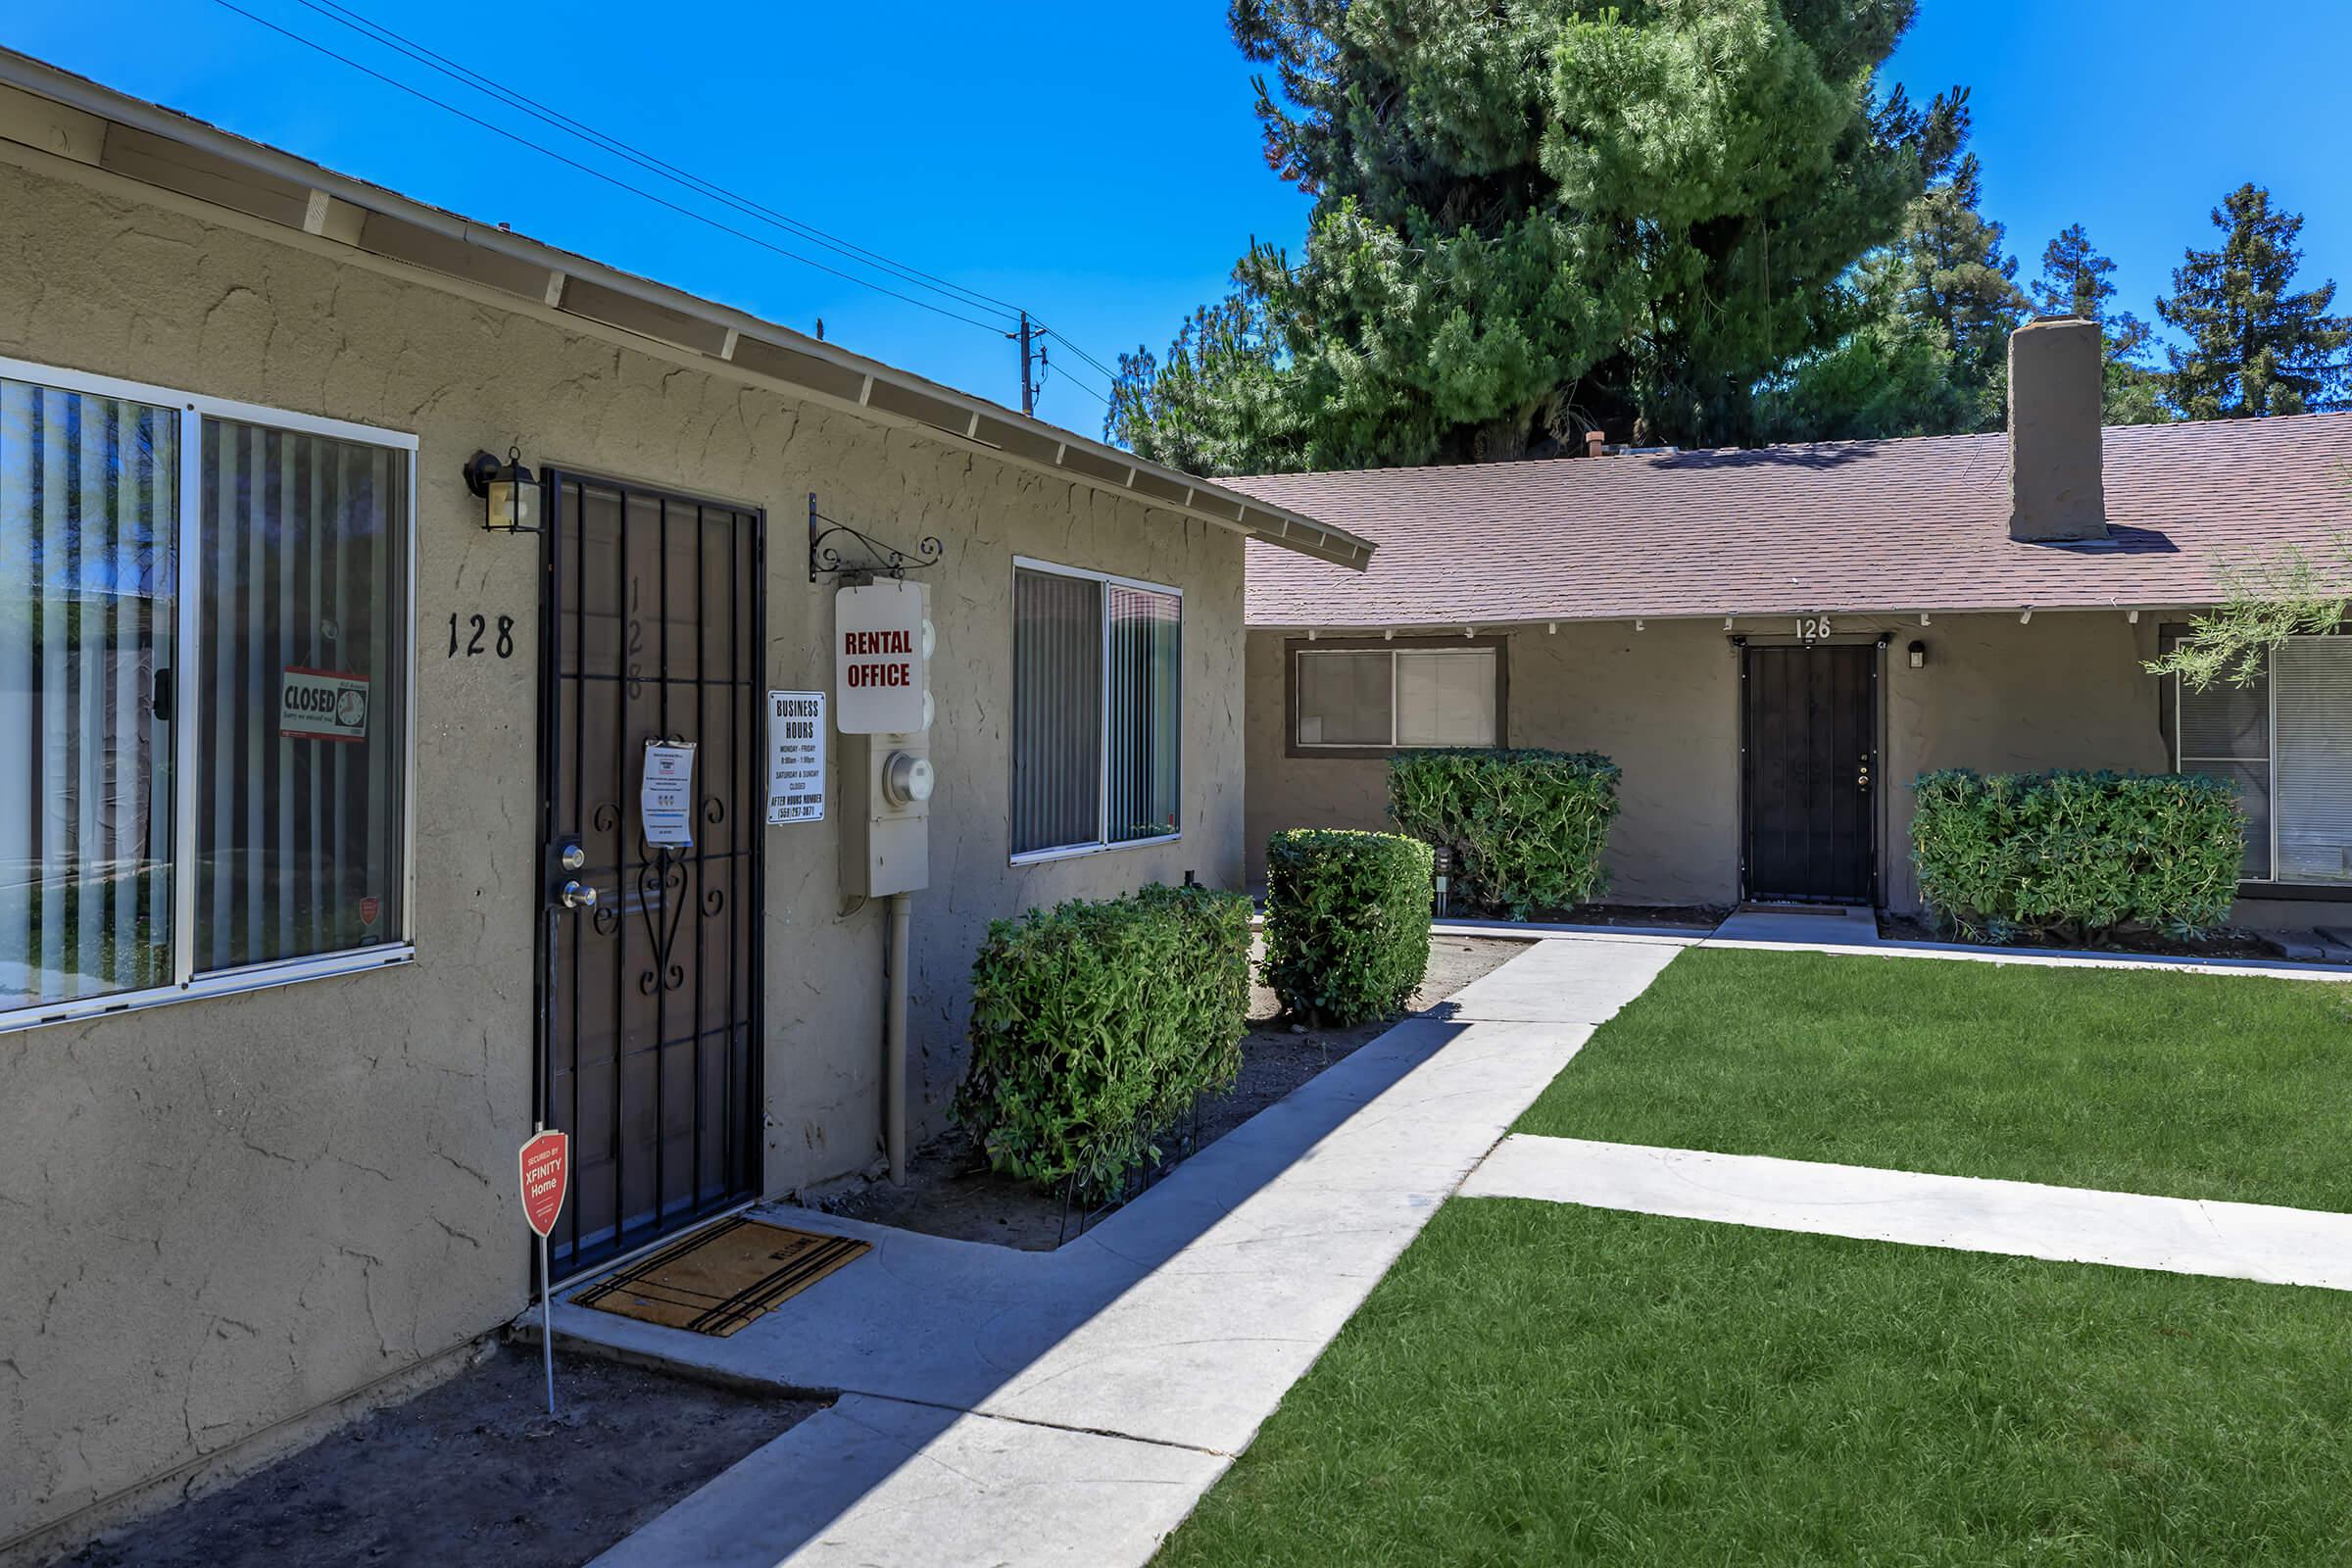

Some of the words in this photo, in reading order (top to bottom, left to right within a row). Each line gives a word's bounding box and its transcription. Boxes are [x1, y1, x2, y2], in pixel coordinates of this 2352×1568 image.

[448, 612, 514, 659] 128
[1796, 615, 1831, 638] 126
[845, 630, 912, 655] RENTAL
[848, 663, 910, 688] OFFICE
[284, 685, 336, 713] CLOSED
[776, 700, 818, 717] BUSINESS
[786, 721, 813, 739] HOURS
[775, 770, 798, 780] SATURDAY
[803, 769, 819, 778] SUNDAY
[771, 796, 786, 807] AFTER
[787, 795, 803, 806] HOURS
[804, 793, 822, 805] NUMBER
[527, 1151, 551, 1166] SECURED
[551, 1147, 560, 1156] BY
[525, 1157, 563, 1186] XFINITY
[531, 1177, 558, 1199] Home
